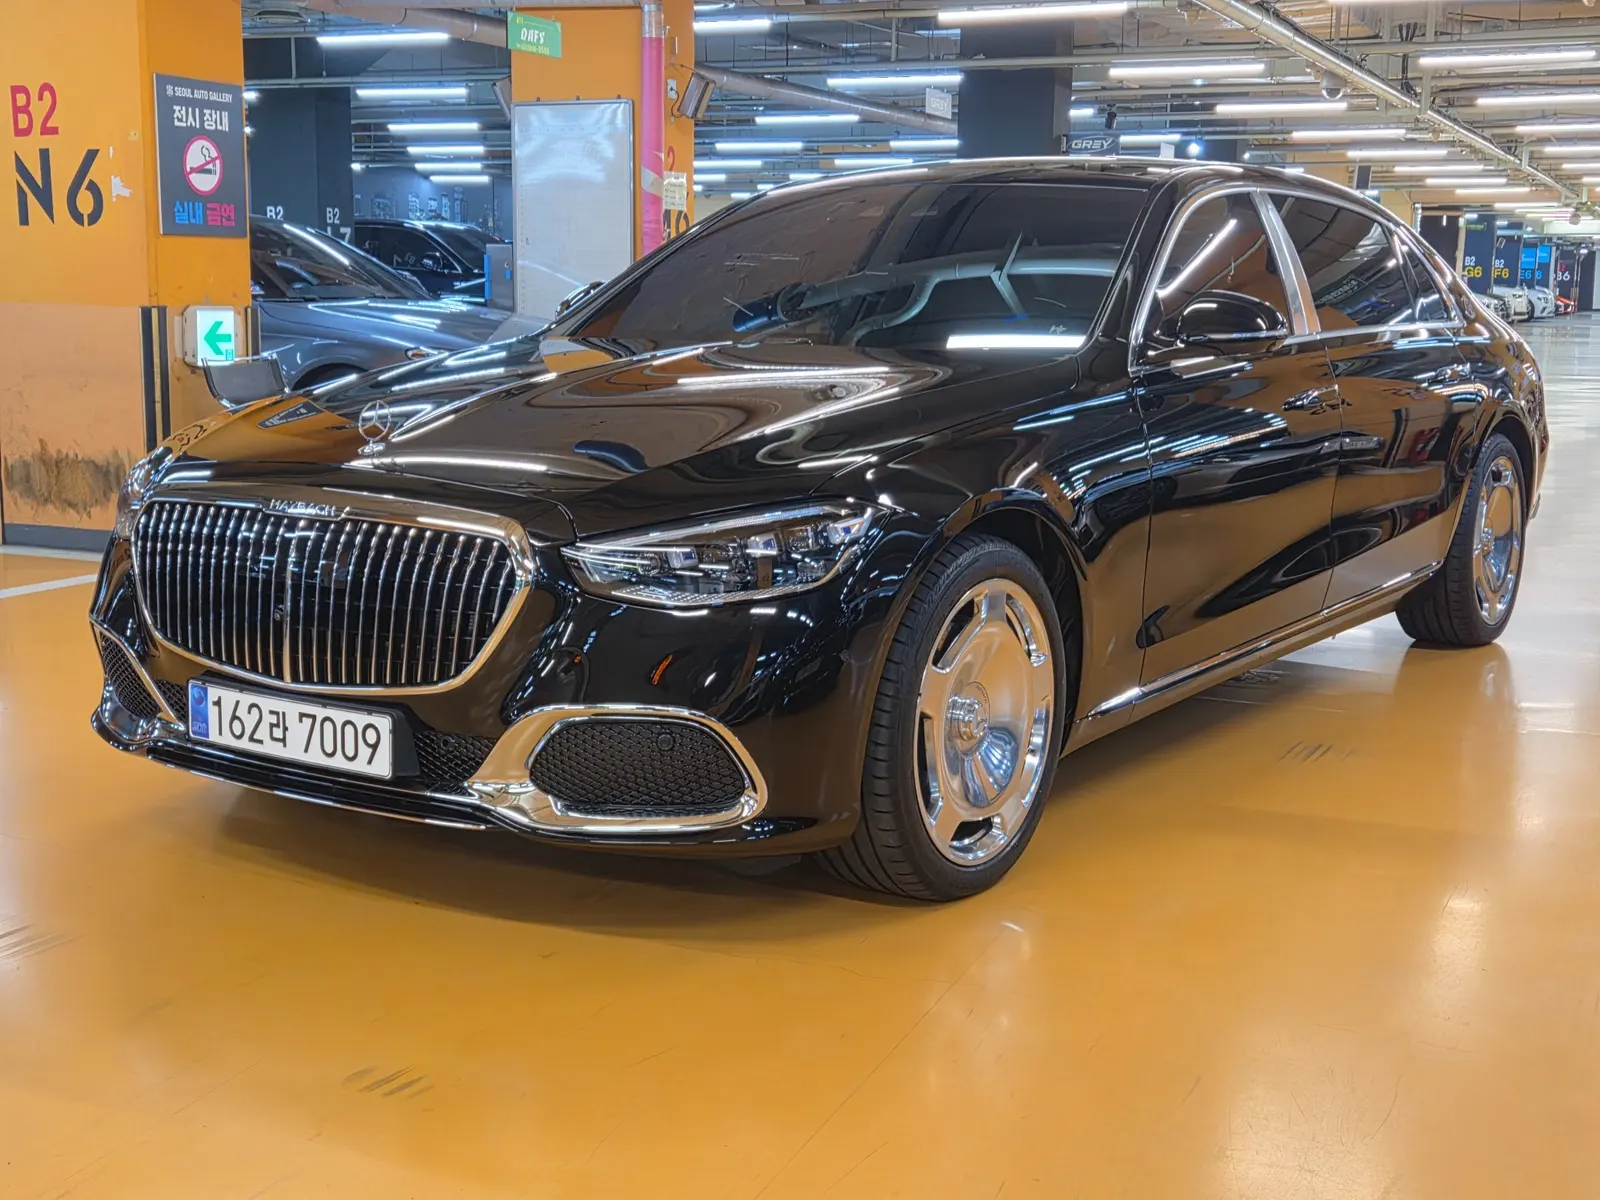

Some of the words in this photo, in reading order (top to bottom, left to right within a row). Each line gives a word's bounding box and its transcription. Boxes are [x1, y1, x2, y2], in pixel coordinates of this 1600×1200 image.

[174, 86, 193, 98] SEOUL
[193, 89, 209, 100] AUTO
[209, 91, 233, 103] GALLERY
[10, 82, 59, 137] B2
[173, 105, 200, 129] 전시
[203, 108, 229, 132] 장내
[1071, 136, 1114, 150] GREY
[174, 200, 203, 225] 실내
[206, 202, 235, 227] 금연
[266, 205, 284, 221] B2
[326, 207, 340, 224] B2
[1464, 255, 1476, 266] B2
[1494, 259, 1505, 268] B2
[1465, 266, 1483, 278] G6
[1493, 268, 1509, 279] F6
[211, 695, 289, 749] 162라
[298, 711, 382, 766] 7009
